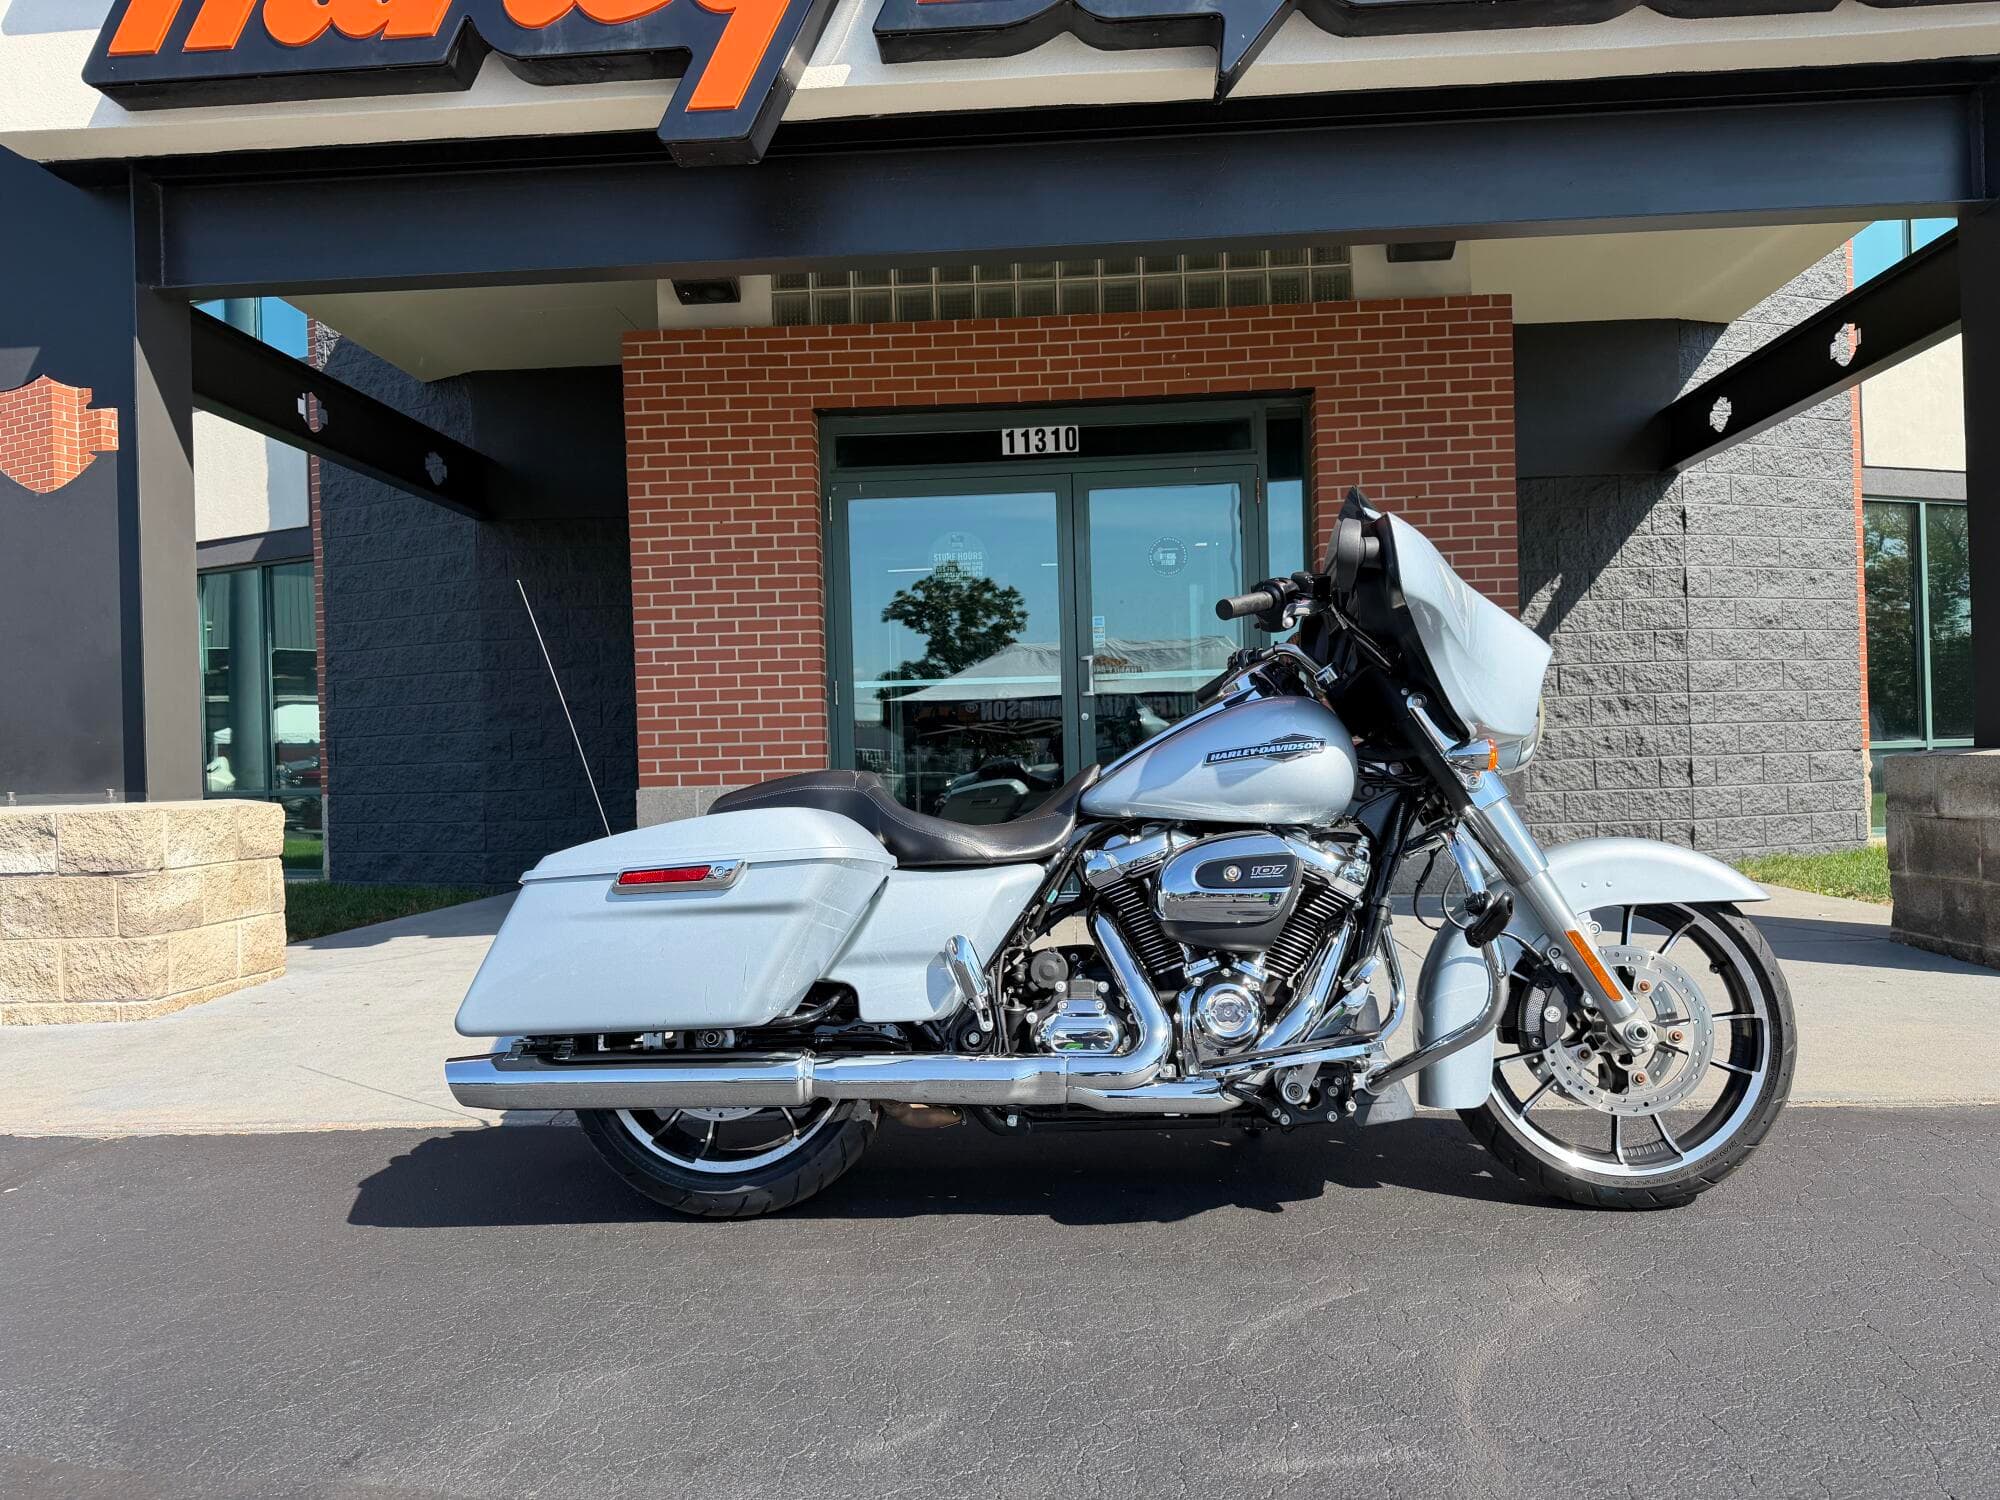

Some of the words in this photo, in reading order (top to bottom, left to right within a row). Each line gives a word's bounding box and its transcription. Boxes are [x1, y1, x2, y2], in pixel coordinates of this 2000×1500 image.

[1005, 426, 1077, 454] 11310
[957, 551, 983, 561] HOURS
[1210, 741, 1321, 761] HARLEY-DAVIDSON
[1251, 864, 1288, 876] 107
